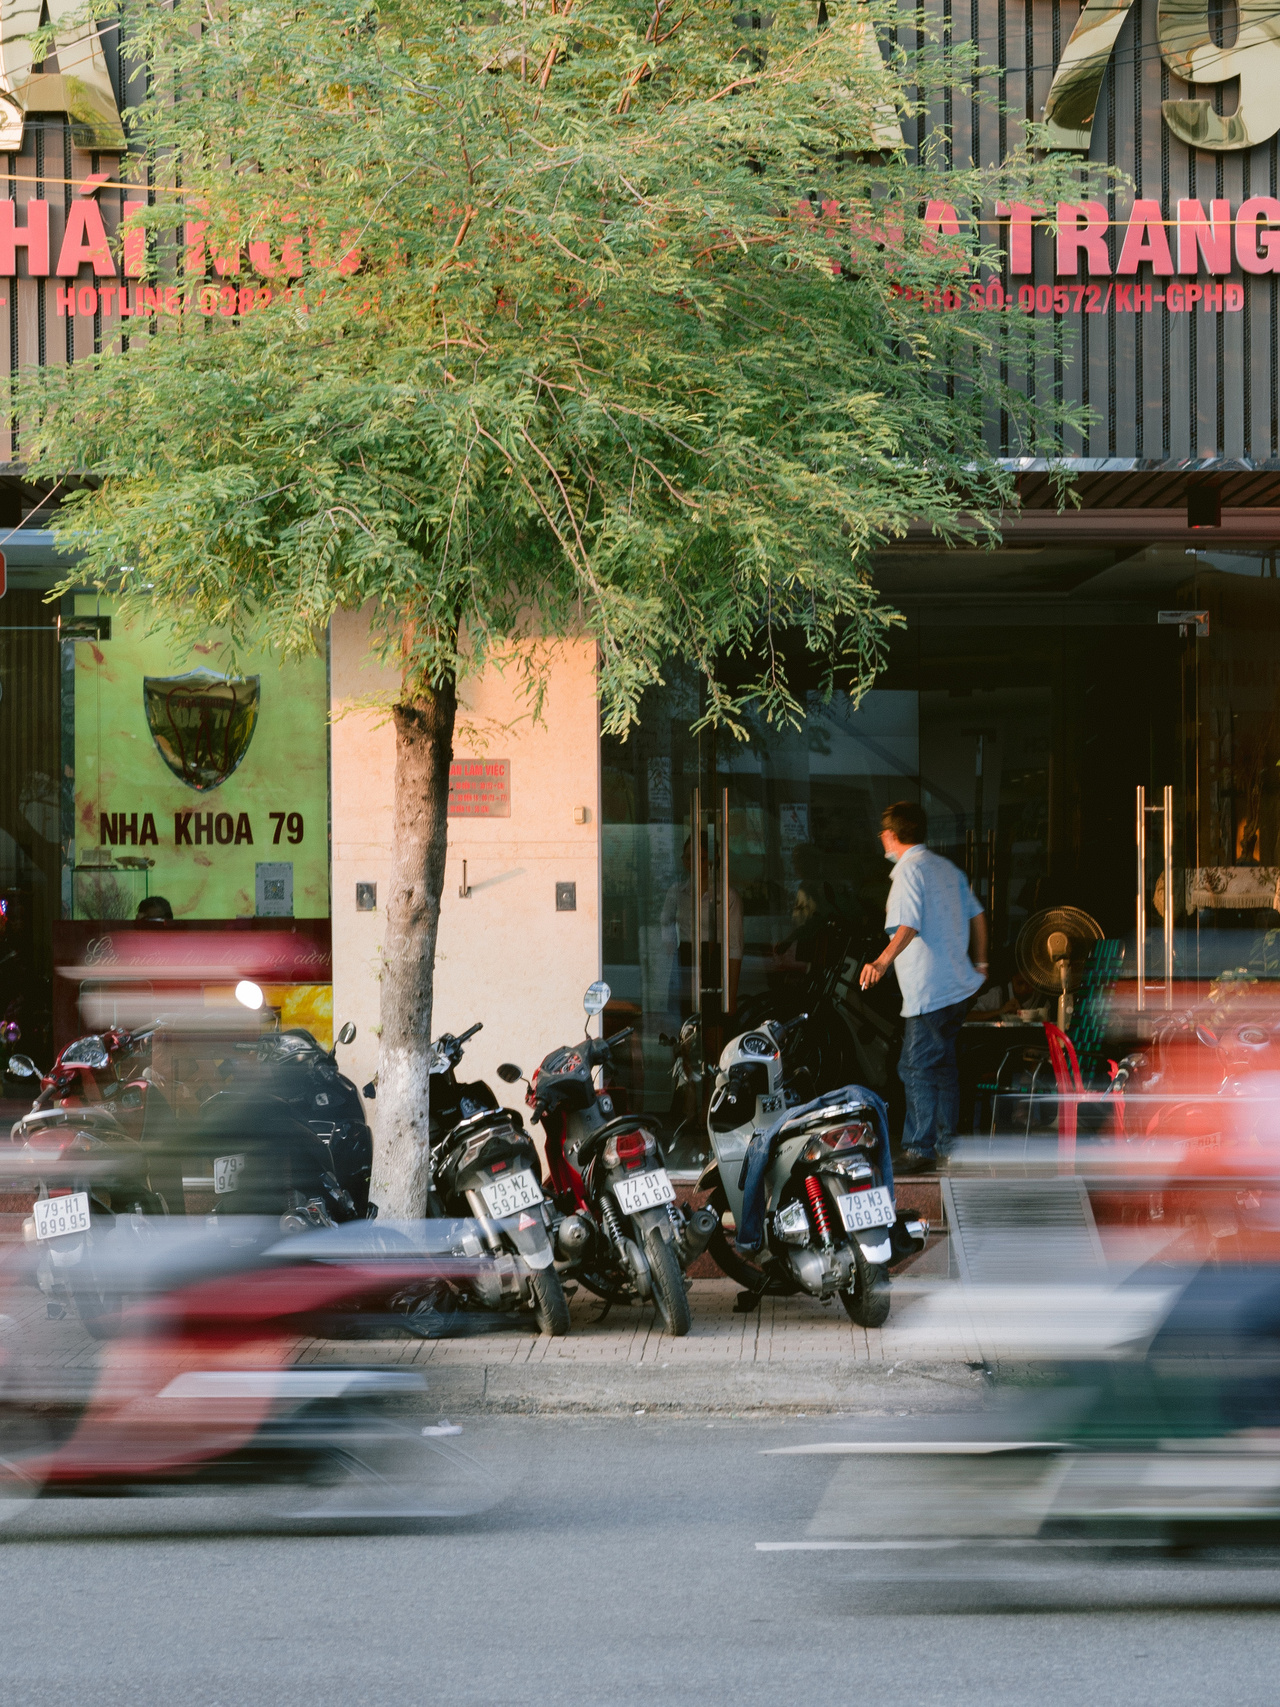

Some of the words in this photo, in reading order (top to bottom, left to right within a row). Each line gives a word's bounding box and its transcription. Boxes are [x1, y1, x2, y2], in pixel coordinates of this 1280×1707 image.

[100, 812, 159, 846] NHA
[174, 812, 254, 846] KHOA
[269, 812, 304, 845] 79
[43, 1197, 79, 1219] 79-H1
[492, 1187, 540, 1216] 592.84
[625, 1187, 671, 1210] 481.60
[40, 1212, 87, 1236] 899.95
[846, 1206, 893, 1229] 069.36
